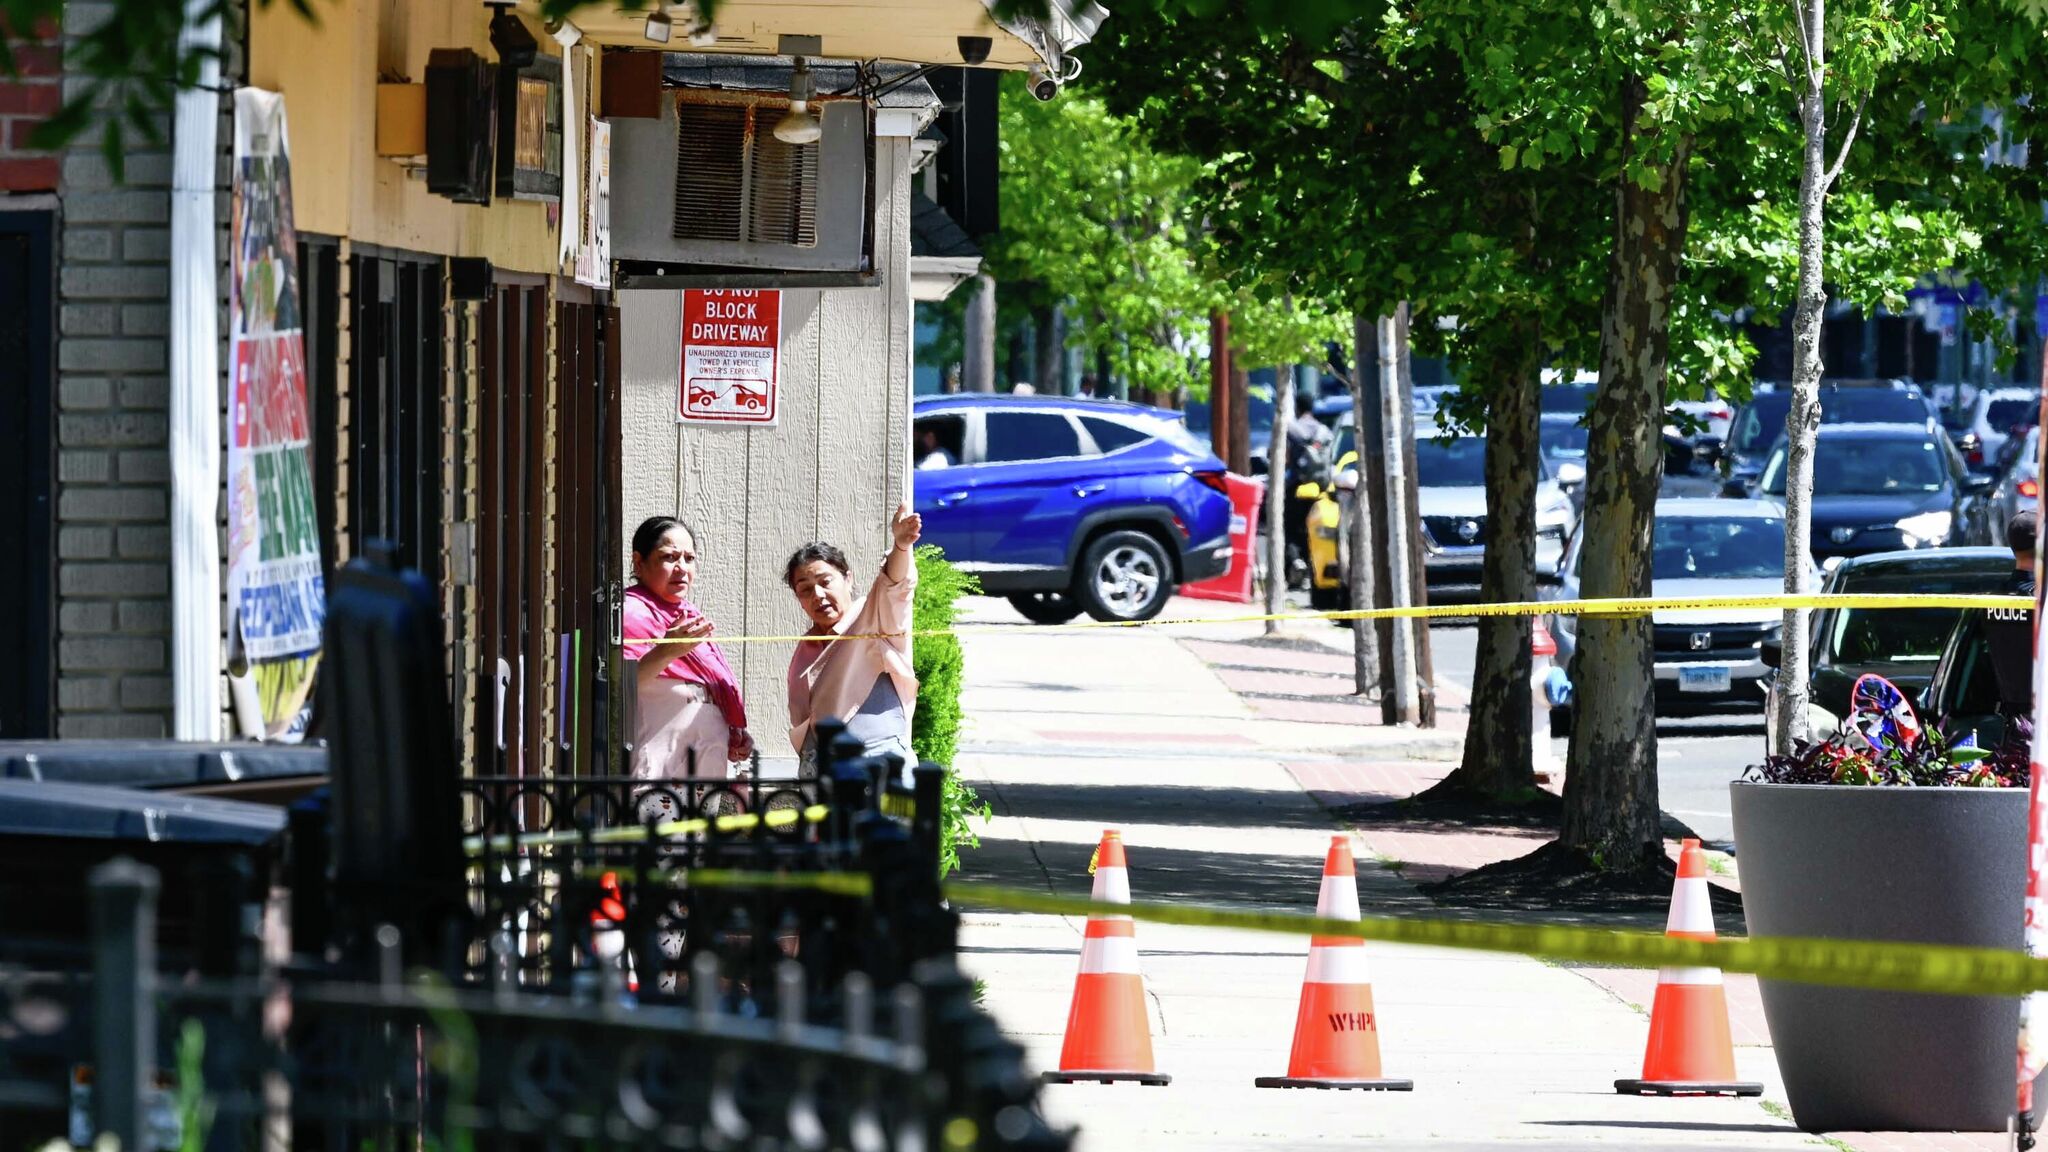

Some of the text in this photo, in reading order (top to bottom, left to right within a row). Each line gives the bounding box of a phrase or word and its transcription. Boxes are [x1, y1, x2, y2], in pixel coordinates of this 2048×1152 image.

[706, 301, 756, 319] BLOCK
[692, 323, 768, 341] DRIVEWAY
[688, 349, 771, 359] UNAUTHORIZED VEHICLES
[699, 358, 721, 366] TOWED
[733, 359, 759, 367] VEHICLE
[699, 367, 728, 375] OWNER'S
[1988, 607, 2027, 620] POLICE
